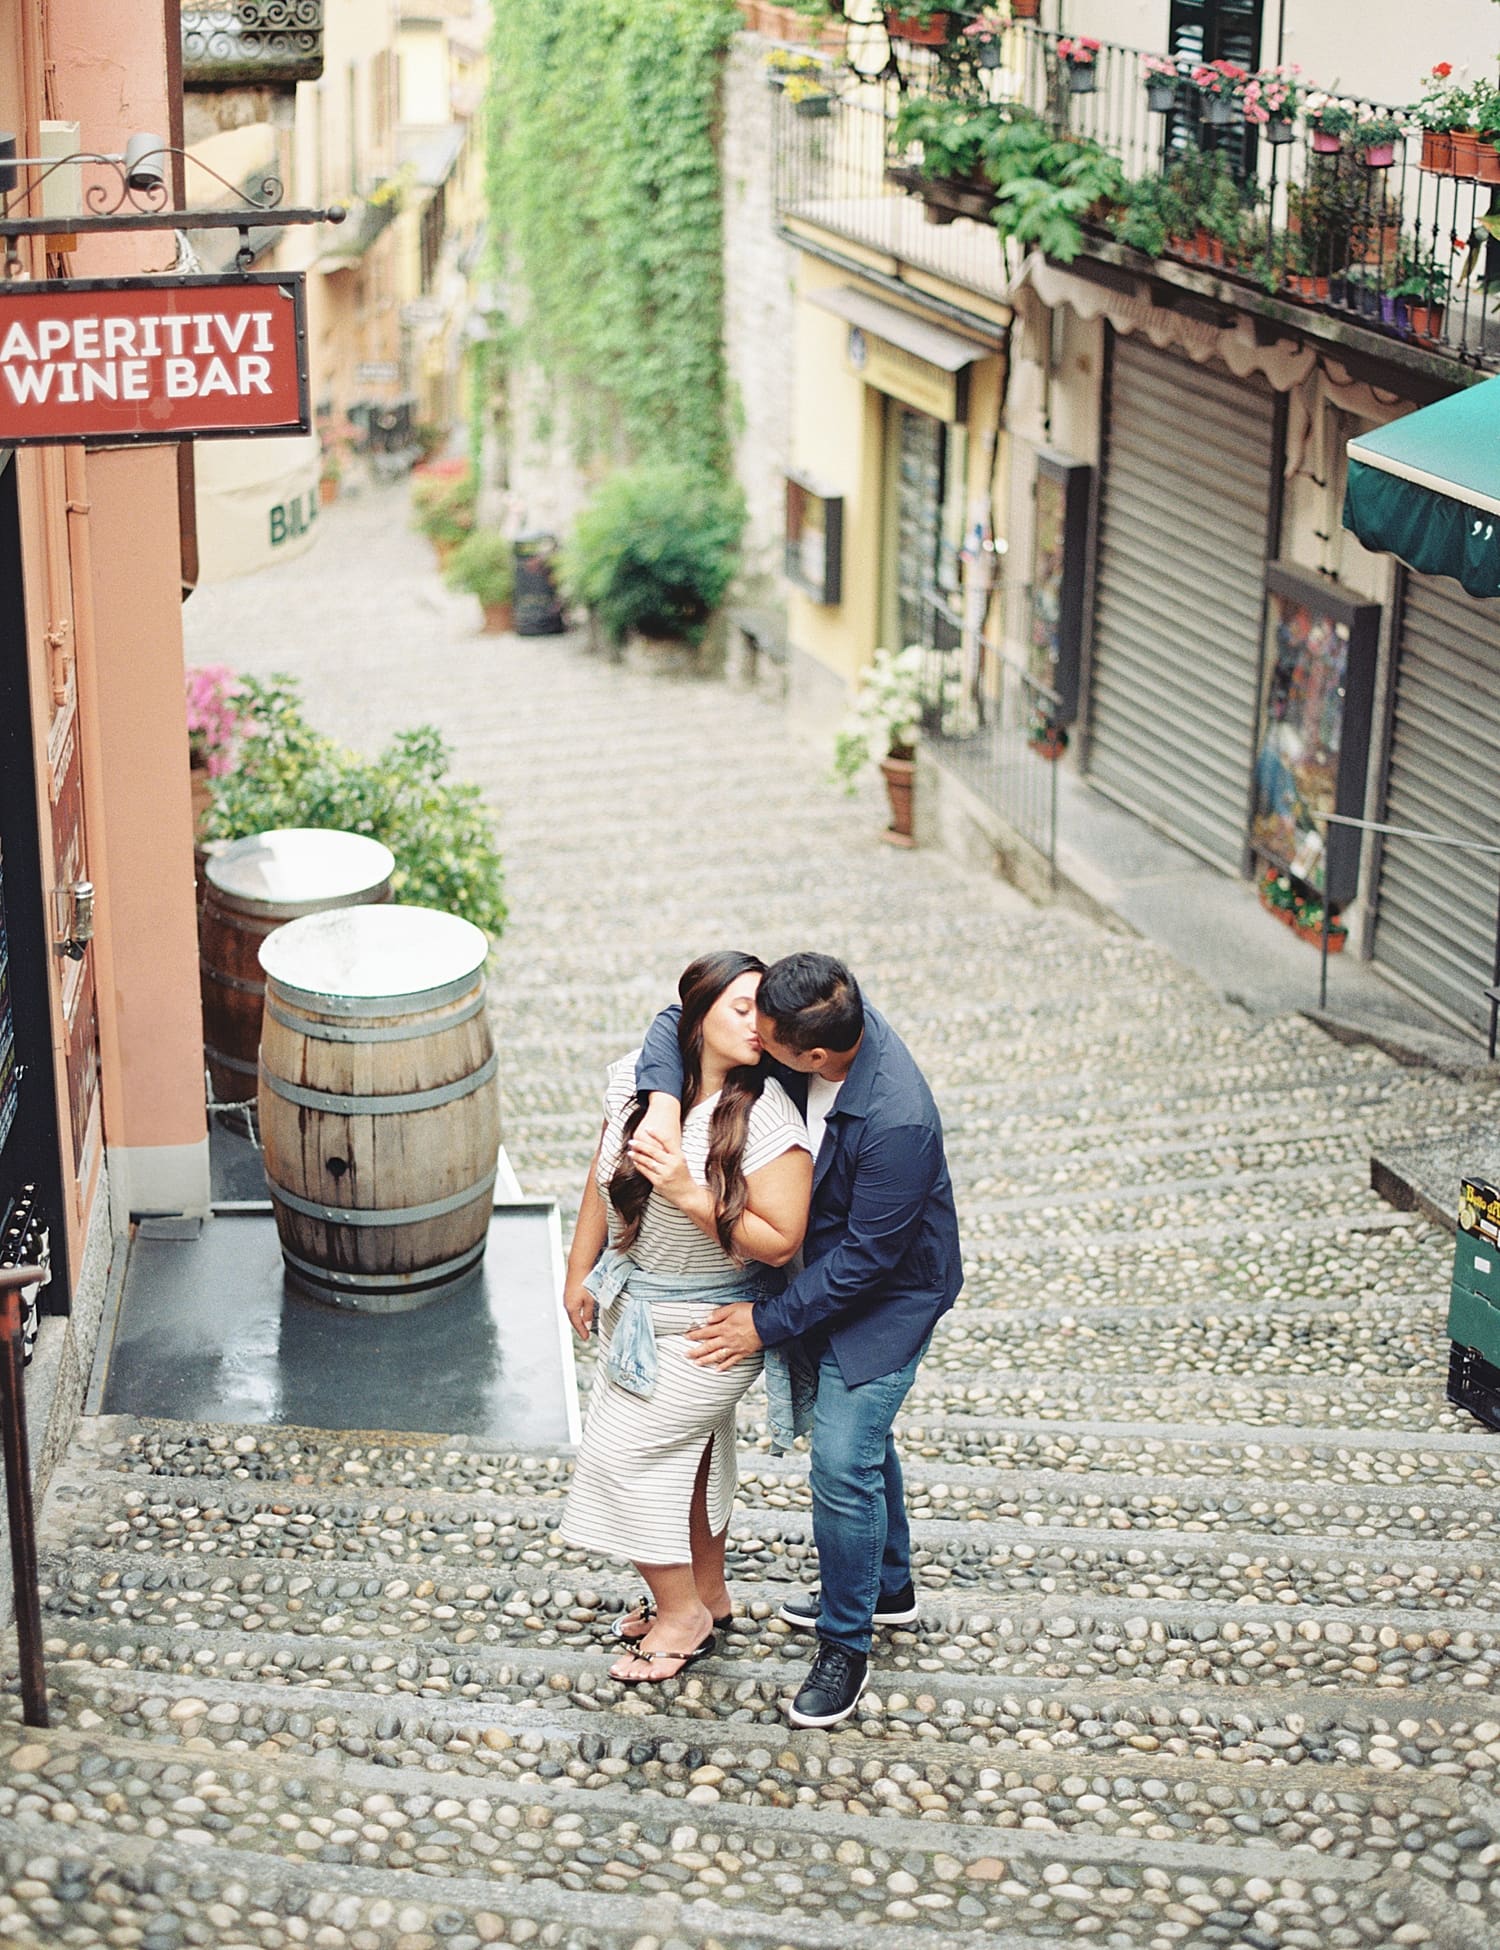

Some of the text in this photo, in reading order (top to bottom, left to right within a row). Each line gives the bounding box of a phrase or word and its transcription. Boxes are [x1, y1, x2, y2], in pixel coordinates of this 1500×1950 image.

[0, 313, 274, 361] APERITIVI
[3, 356, 273, 404] WINE BAR
